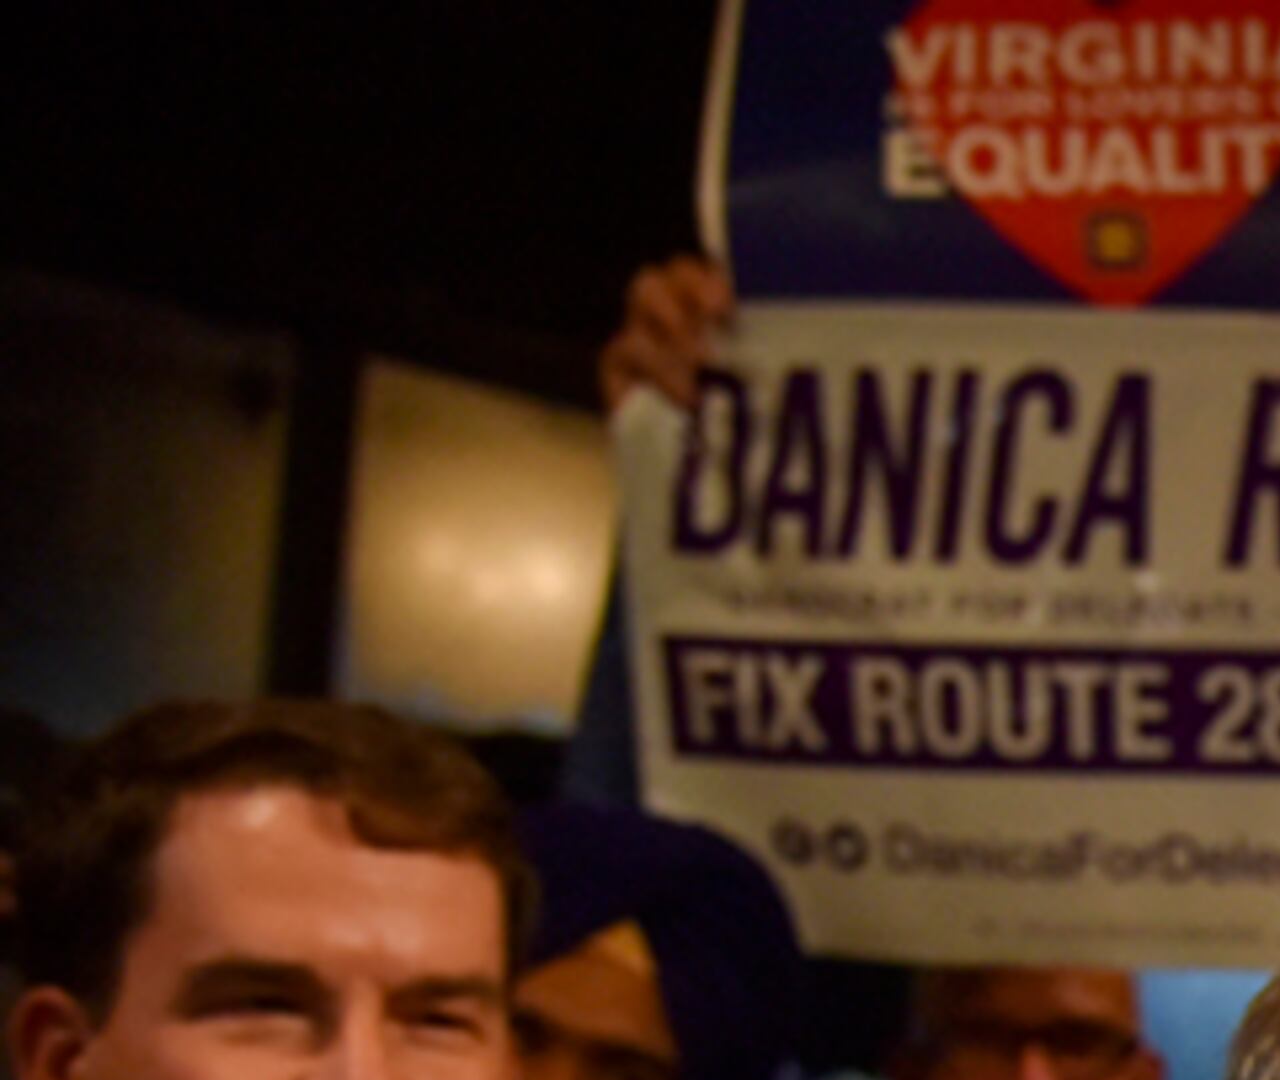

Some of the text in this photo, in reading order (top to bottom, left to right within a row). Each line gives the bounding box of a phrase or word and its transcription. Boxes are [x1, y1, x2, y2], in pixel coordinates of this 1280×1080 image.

[951, 84, 1056, 118] FOR
[1066, 85, 1264, 118] LOVERS
[672, 366, 1152, 568] DANICA
[681, 648, 828, 752] FIX
[851, 654, 1174, 764] ROUTE
